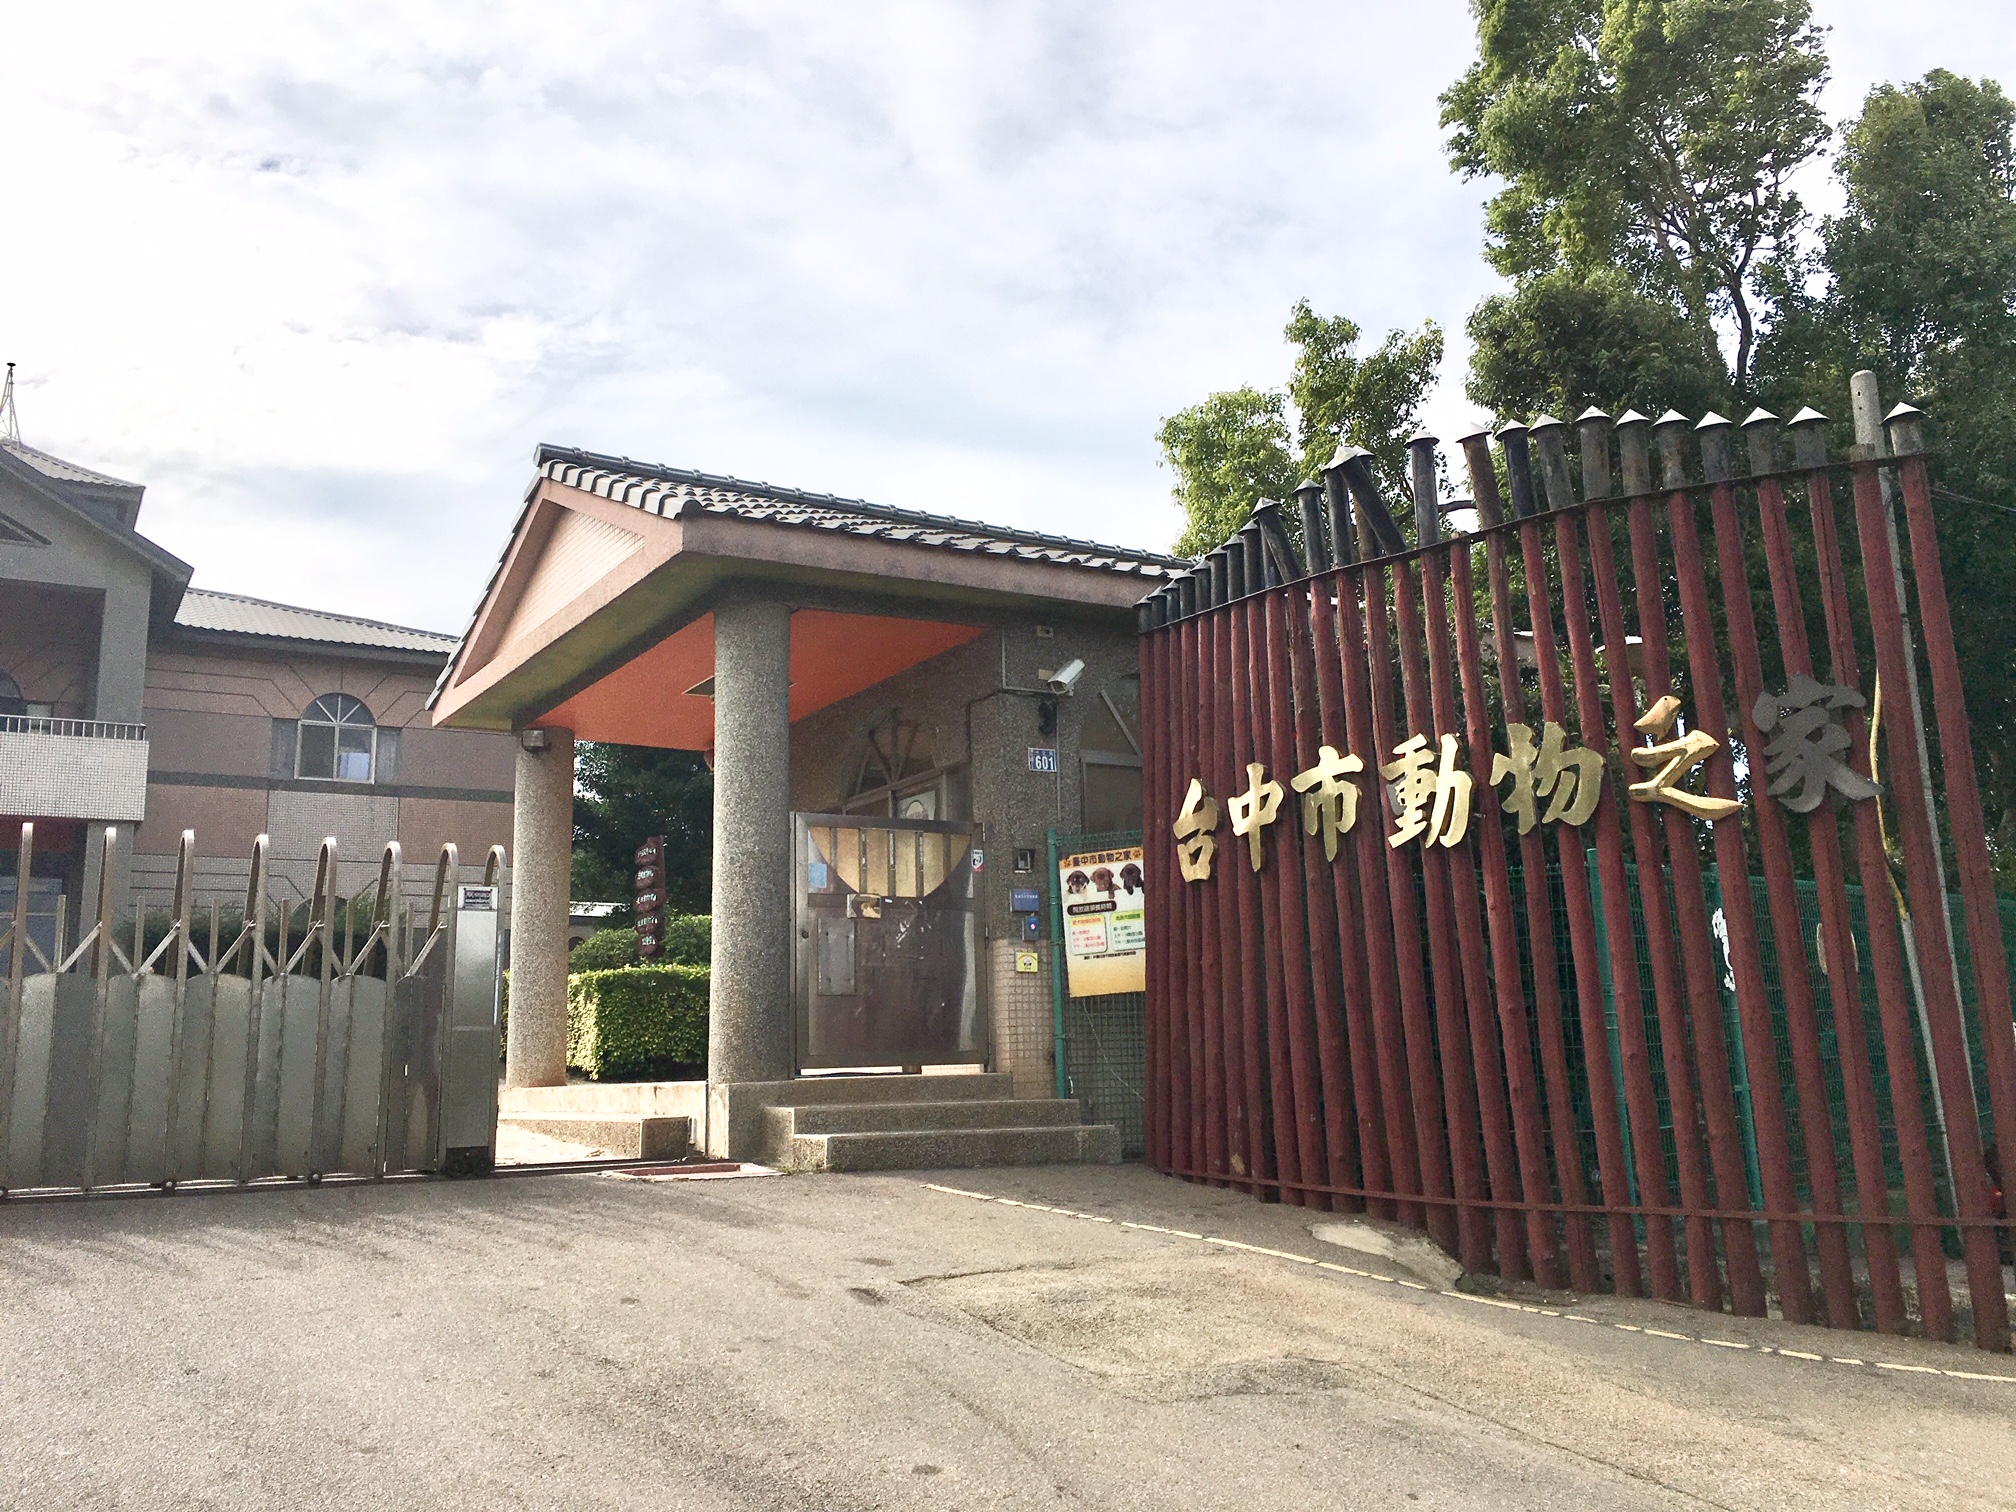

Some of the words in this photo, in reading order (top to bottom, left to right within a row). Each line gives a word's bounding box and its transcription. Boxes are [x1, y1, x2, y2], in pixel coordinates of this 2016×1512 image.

[1035, 755, 1054, 770] 601
[1172, 673, 1885, 883] 台中市動物之家
[1072, 850, 1132, 867] 臺中市動物之家
